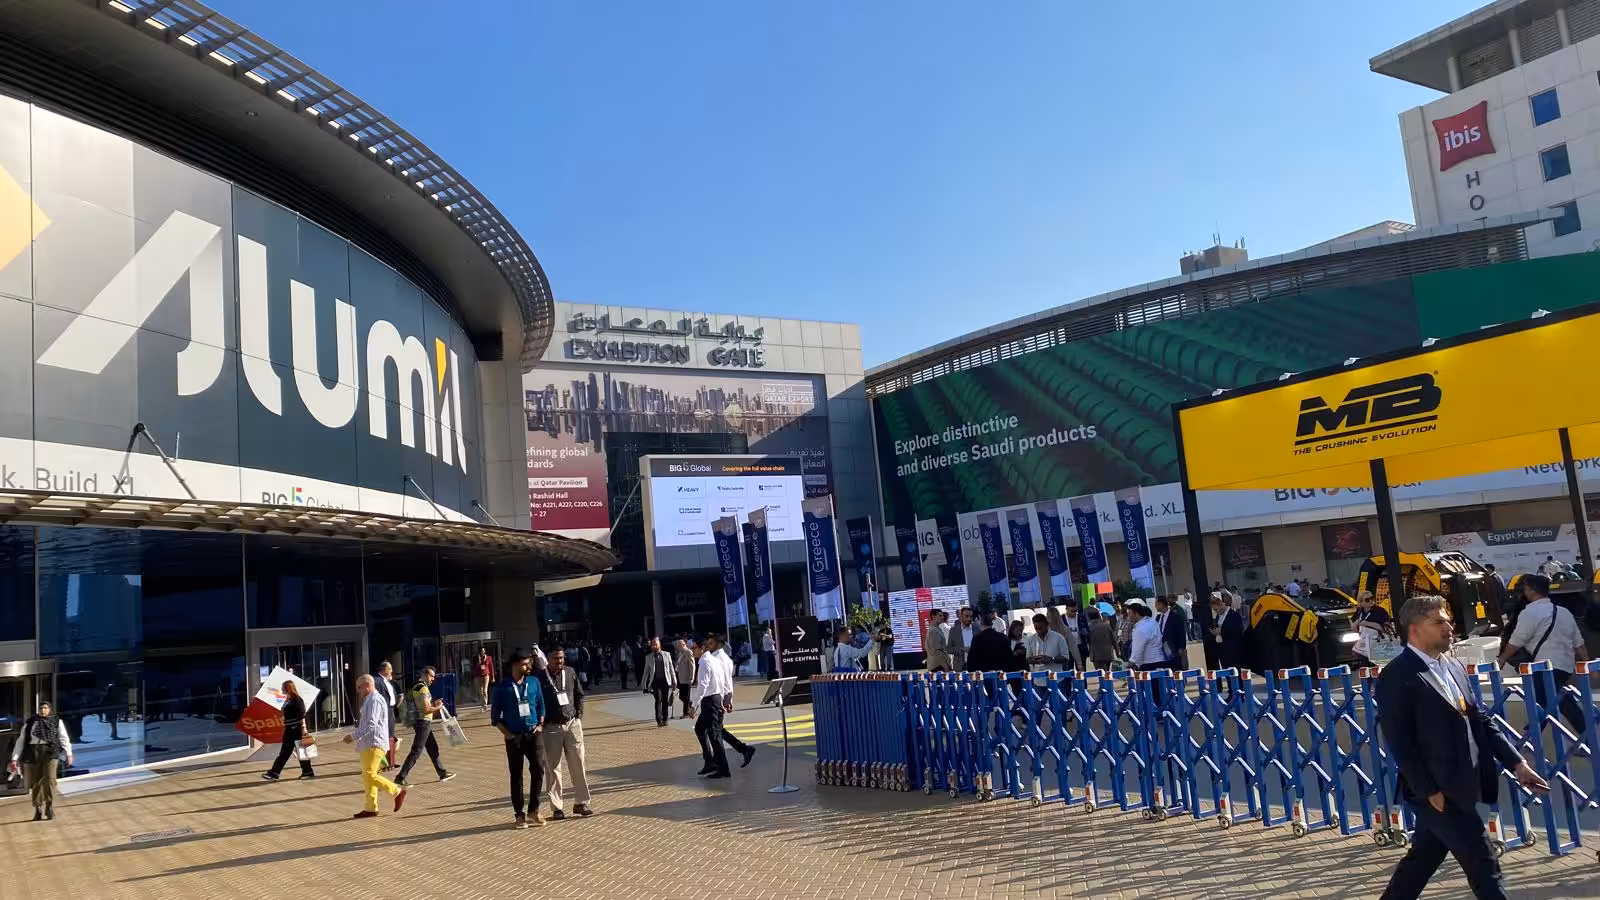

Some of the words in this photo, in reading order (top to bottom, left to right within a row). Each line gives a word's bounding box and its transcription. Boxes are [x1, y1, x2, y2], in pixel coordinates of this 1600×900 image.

[1444, 125, 1482, 151] ibis
[563, 338, 690, 365] EXHIBITION
[706, 346, 766, 368] GATE
[1296, 373, 1442, 437] MB
[560, 446, 588, 459] global
[895, 433, 940, 456] Explore
[943, 415, 1019, 443] distinctive
[897, 459, 919, 477] and
[921, 451, 968, 471] diverse
[971, 436, 1015, 461] Saudi
[1018, 424, 1097, 455] products
[1293, 447, 1312, 456] THE
[1315, 437, 1368, 452] CRUSHING
[1371, 424, 1437, 442] EVOLUTION
[669, 464, 682, 472] BIG
[690, 464, 712, 472] Global
[809, 522, 825, 573] Greece
[985, 530, 997, 568] Greece
[1013, 527, 1026, 567] Greece
[1042, 519, 1055, 560] Greece
[1079, 516, 1093, 558] Greece
[1123, 509, 1138, 551] Greece
[1487, 532, 1515, 543] Egypt
[1517, 528, 1553, 539] Pavilion
[719, 539, 734, 584] Greece
[752, 531, 761, 578] Greece
